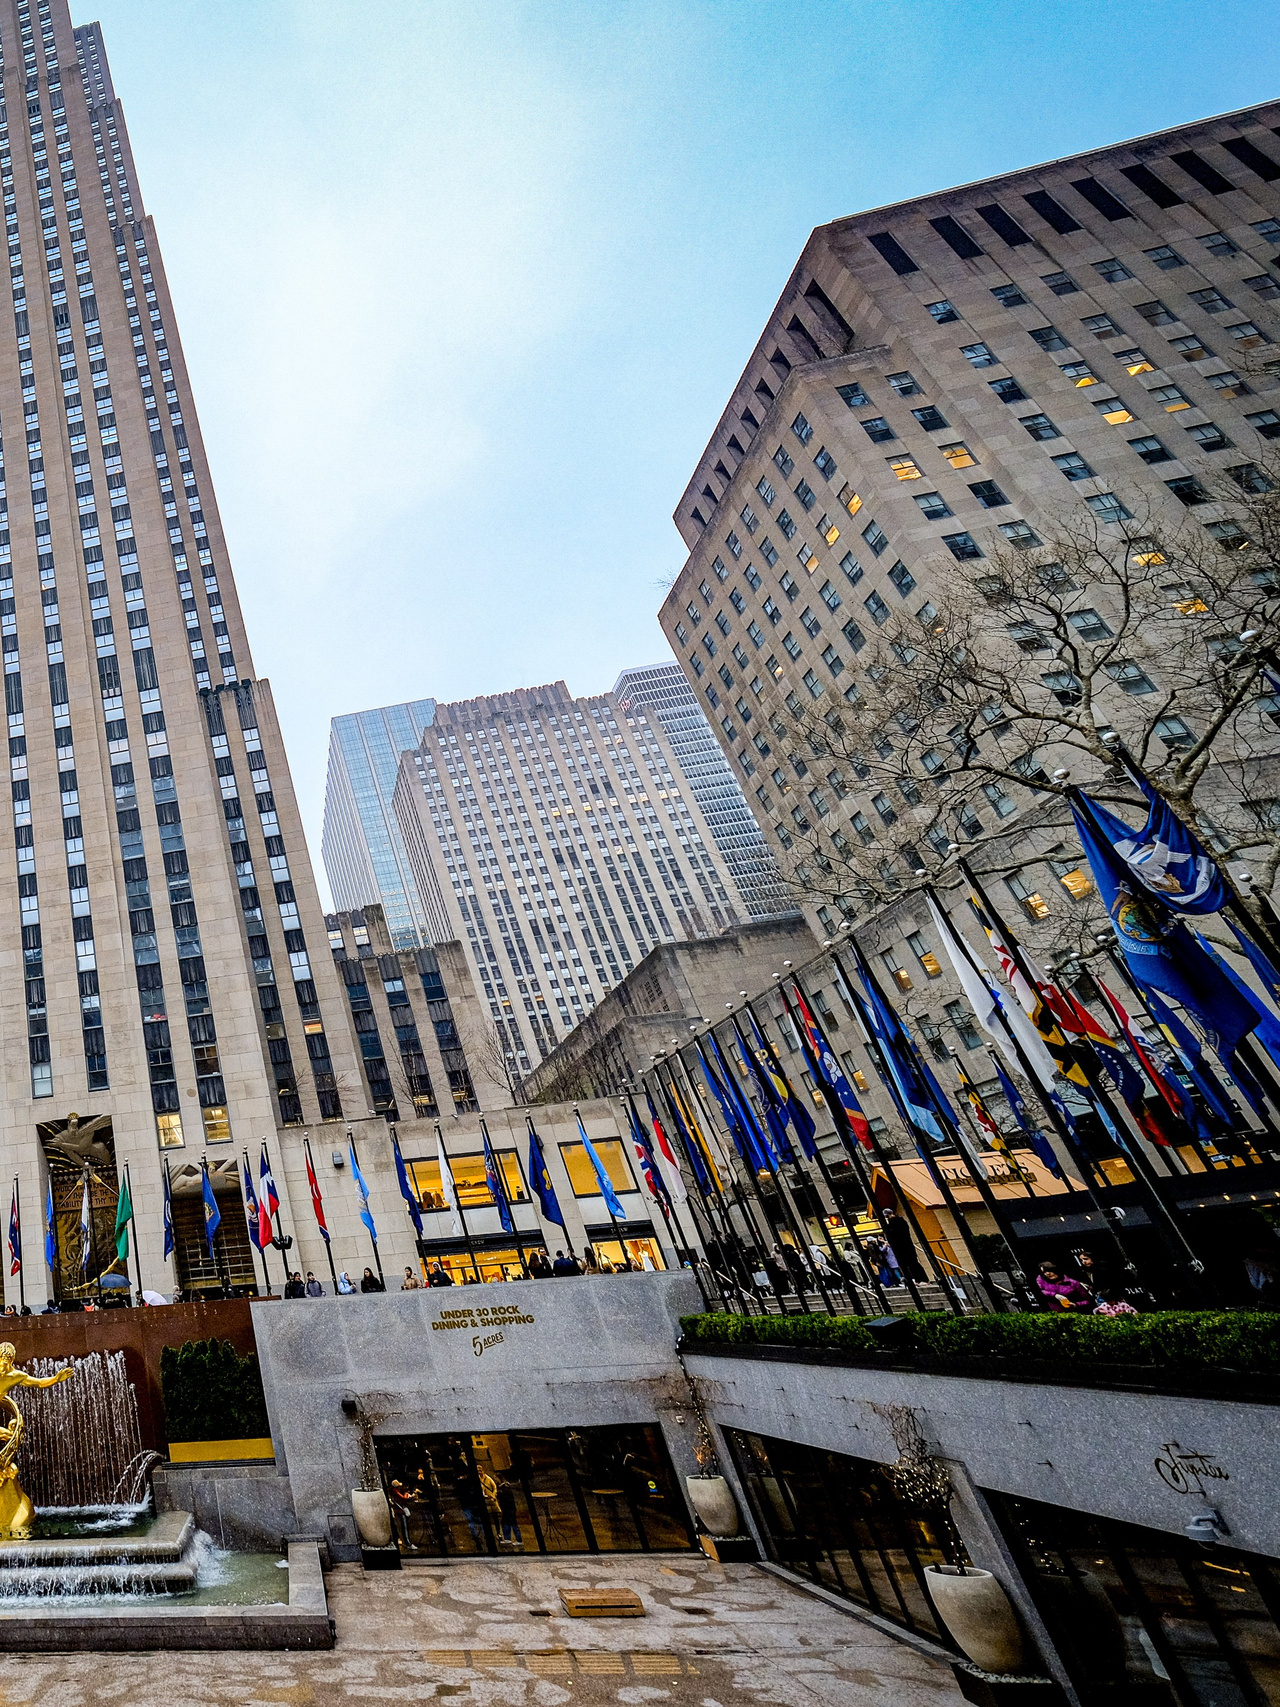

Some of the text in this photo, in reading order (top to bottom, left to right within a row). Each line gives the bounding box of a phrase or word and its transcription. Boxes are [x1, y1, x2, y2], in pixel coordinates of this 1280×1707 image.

[99, 1188, 109, 1196] THE
[440, 1305, 520, 1320] UNDER 30 ROCK
[431, 1315, 535, 1331] DINING & SHOPPING
[472, 1331, 504, 1357] 5 ACRES
